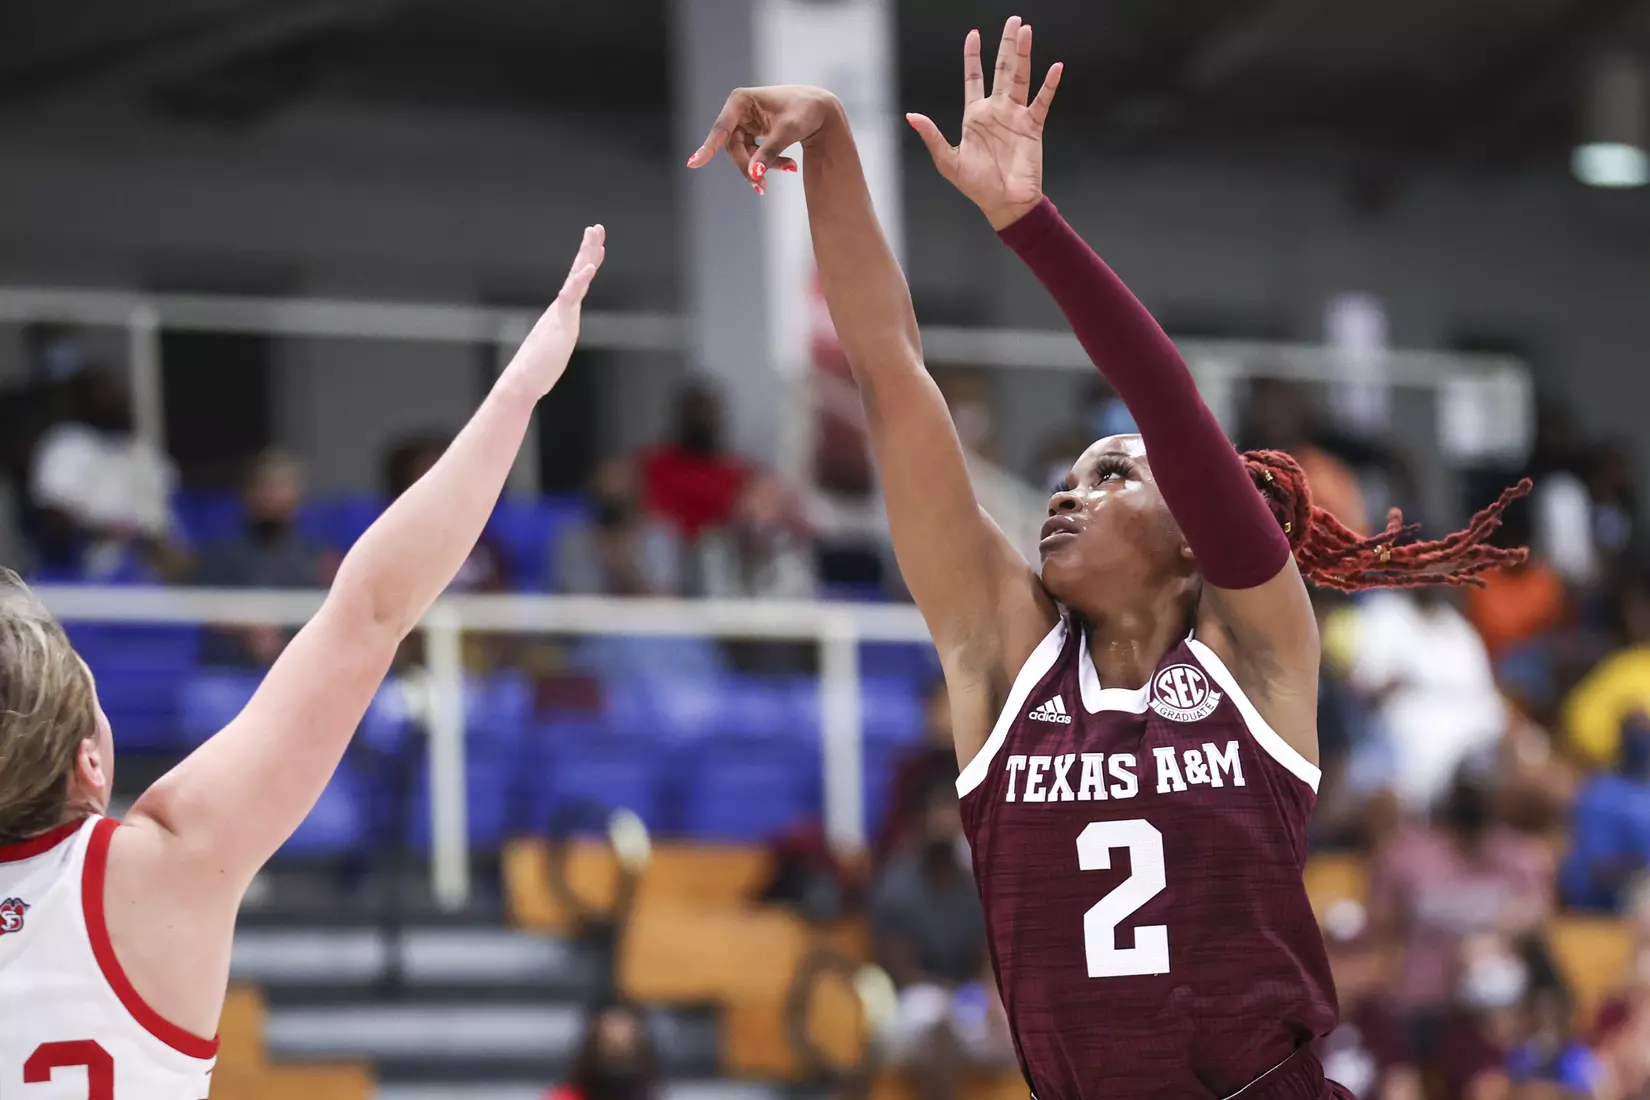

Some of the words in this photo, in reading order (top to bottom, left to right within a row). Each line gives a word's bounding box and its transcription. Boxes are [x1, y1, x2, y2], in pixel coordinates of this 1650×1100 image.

[1158, 667, 1205, 708] SEC
[1028, 710, 1072, 724] adidas
[1159, 702, 1215, 721] GRADUATE
[1005, 753, 1139, 802] TEXAS
[1152, 740, 1246, 794] A&M
[1075, 818, 1171, 978] 2
